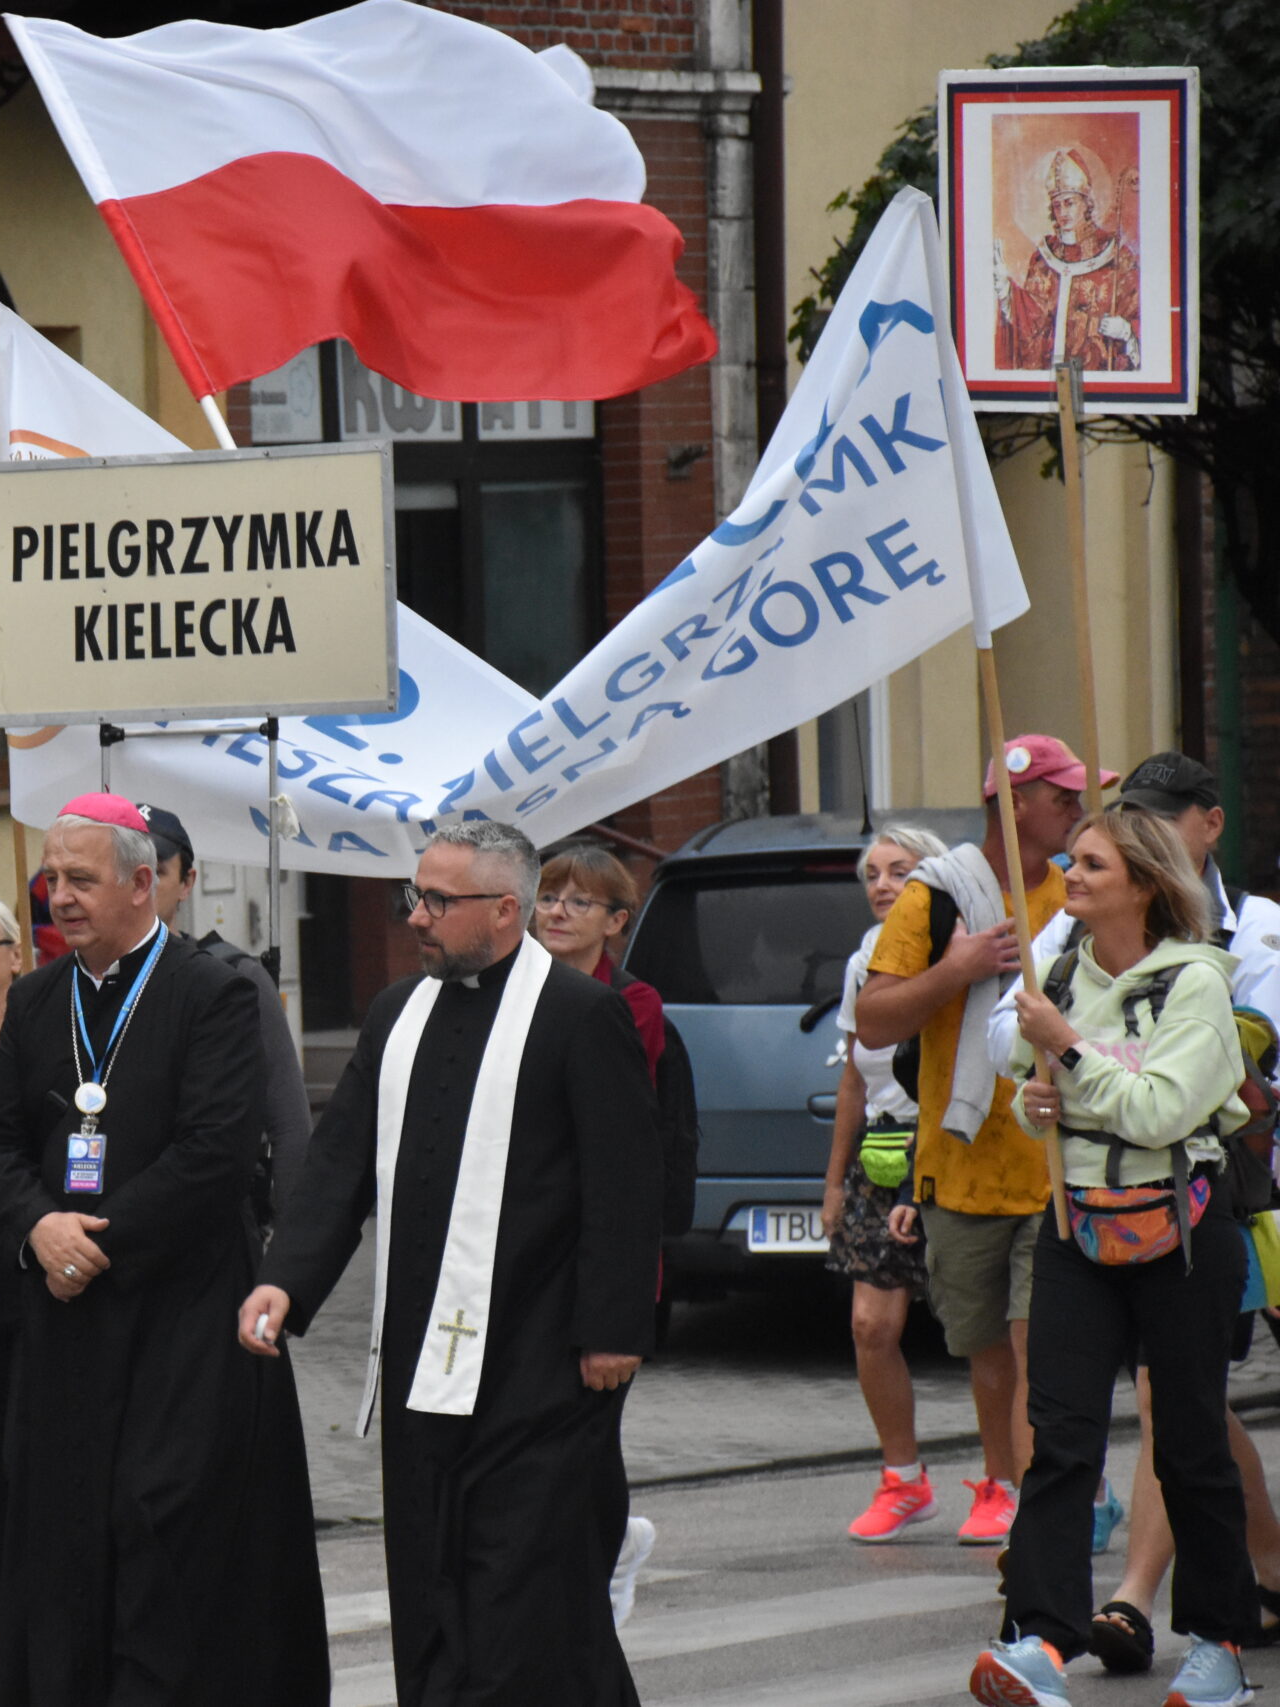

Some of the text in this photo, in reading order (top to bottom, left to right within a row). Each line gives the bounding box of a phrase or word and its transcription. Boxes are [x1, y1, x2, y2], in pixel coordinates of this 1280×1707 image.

[11, 509, 360, 582] PIELGRZYMKA
[75, 596, 297, 662] KIELECKA
[700, 517, 947, 681] GÓRĘ
